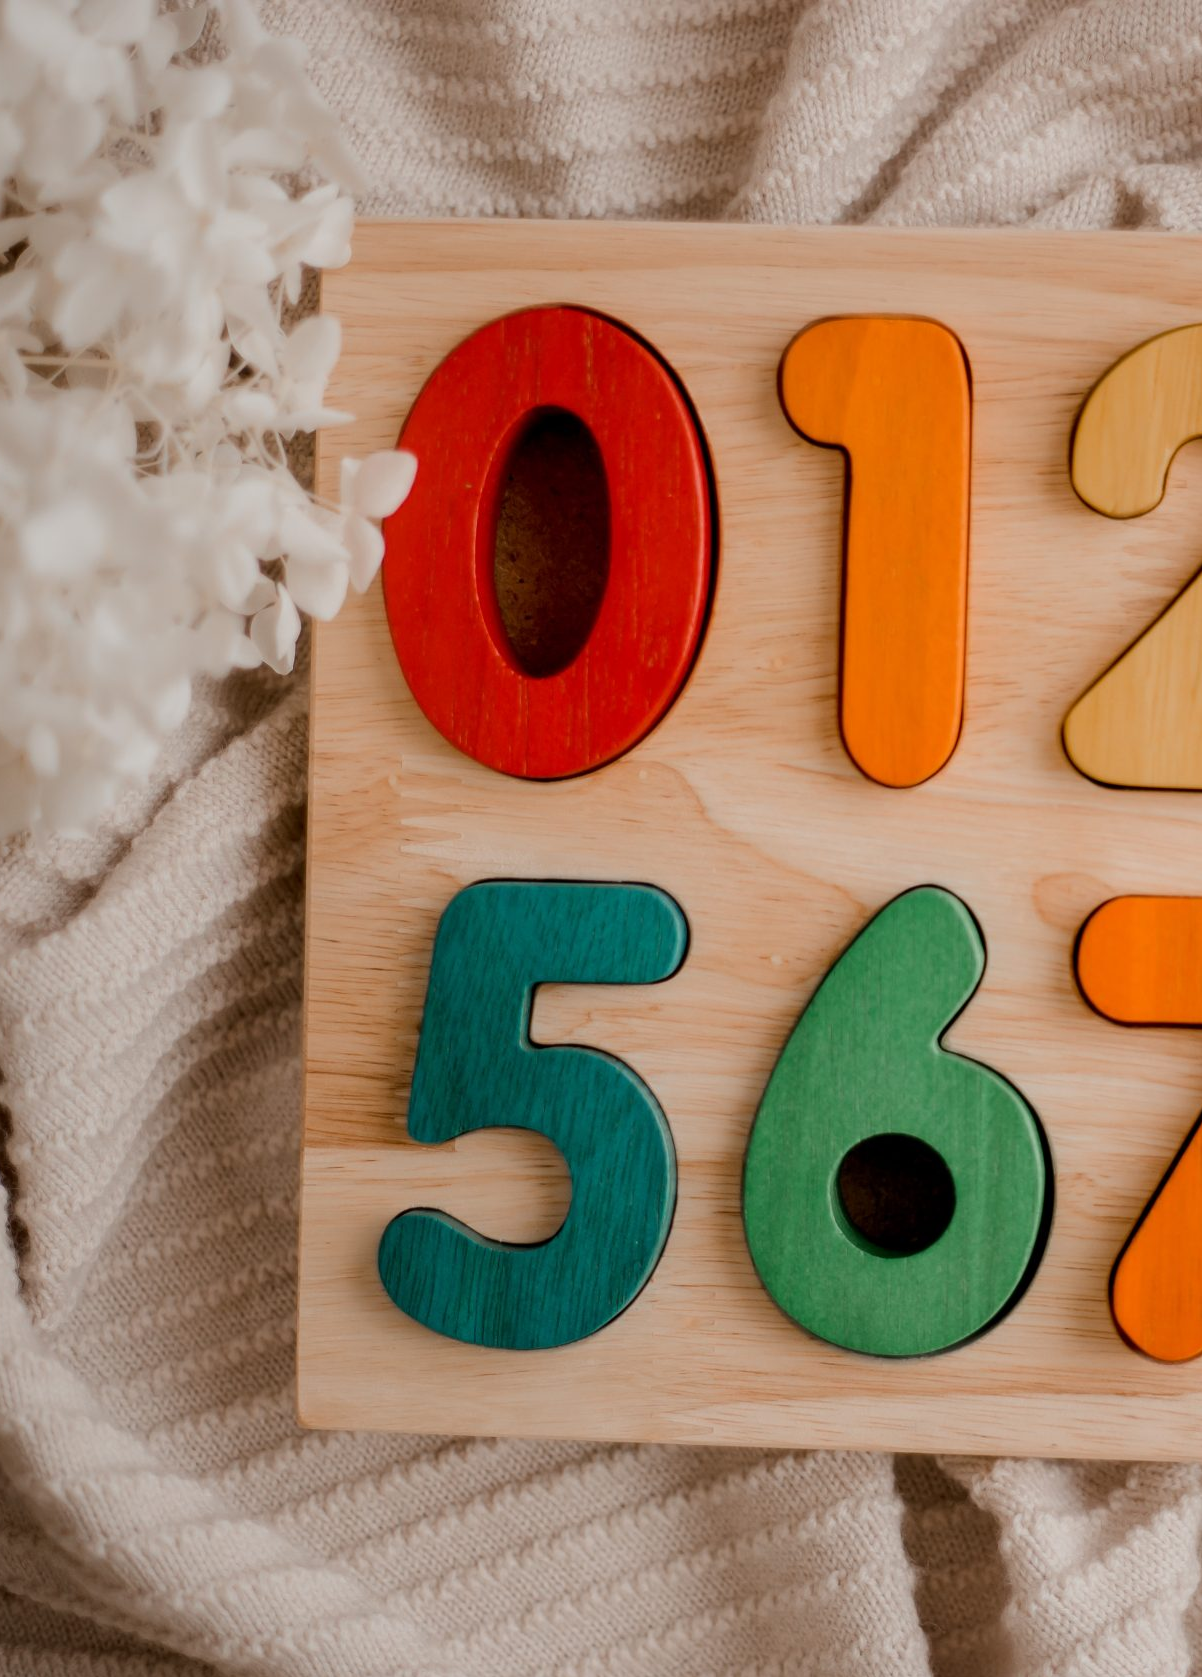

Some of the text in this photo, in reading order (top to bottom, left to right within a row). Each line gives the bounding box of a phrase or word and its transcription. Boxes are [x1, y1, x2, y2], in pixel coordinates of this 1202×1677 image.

[383, 303, 714, 781] 0
[778, 314, 972, 788] 1
[377, 880, 690, 1351] 5
[743, 886, 1051, 1358] 6
